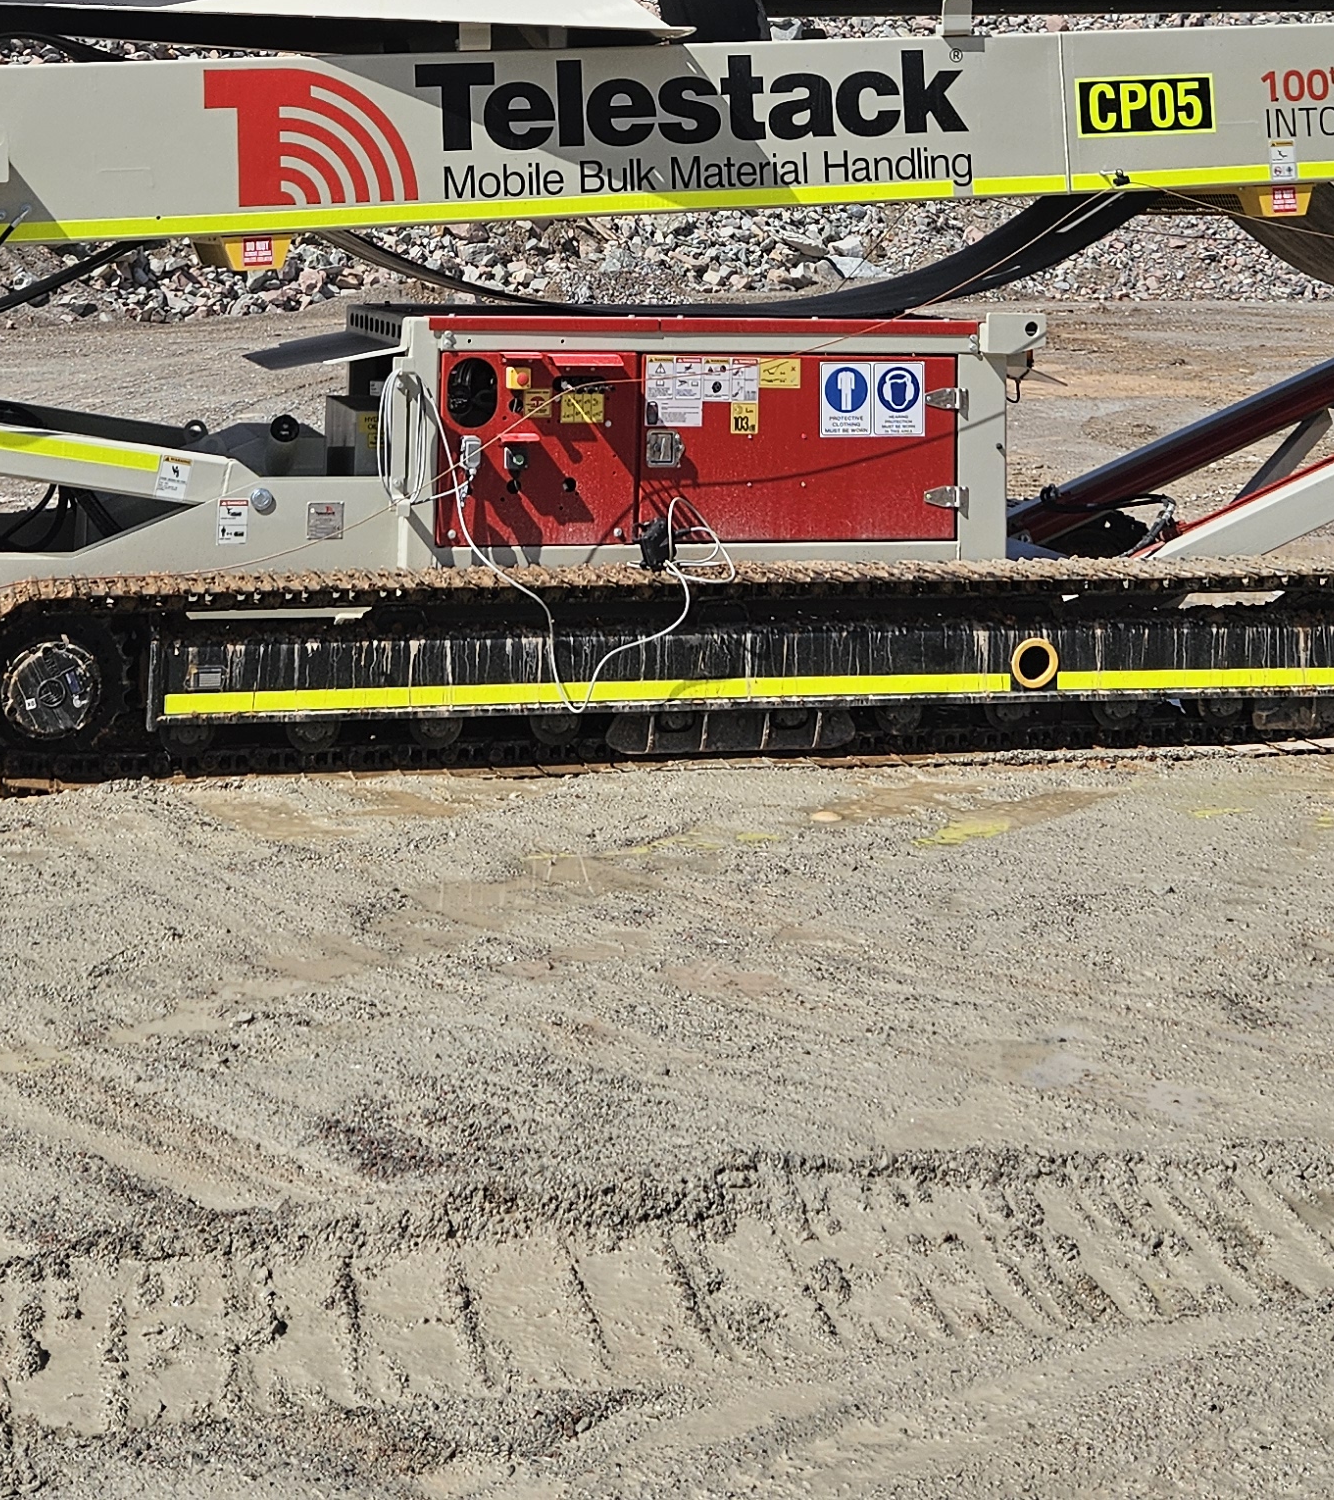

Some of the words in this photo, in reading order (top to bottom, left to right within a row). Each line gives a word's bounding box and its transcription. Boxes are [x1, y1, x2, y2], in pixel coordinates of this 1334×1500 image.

[414, 49, 970, 152] Telestack
[1088, 81, 1203, 131] CP05
[443, 162, 564, 199] Mobile
[579, 158, 656, 193] Bulk
[670, 150, 809, 191] Material
[823, 146, 972, 187] Handling
[733, 415, 749, 431] 103
